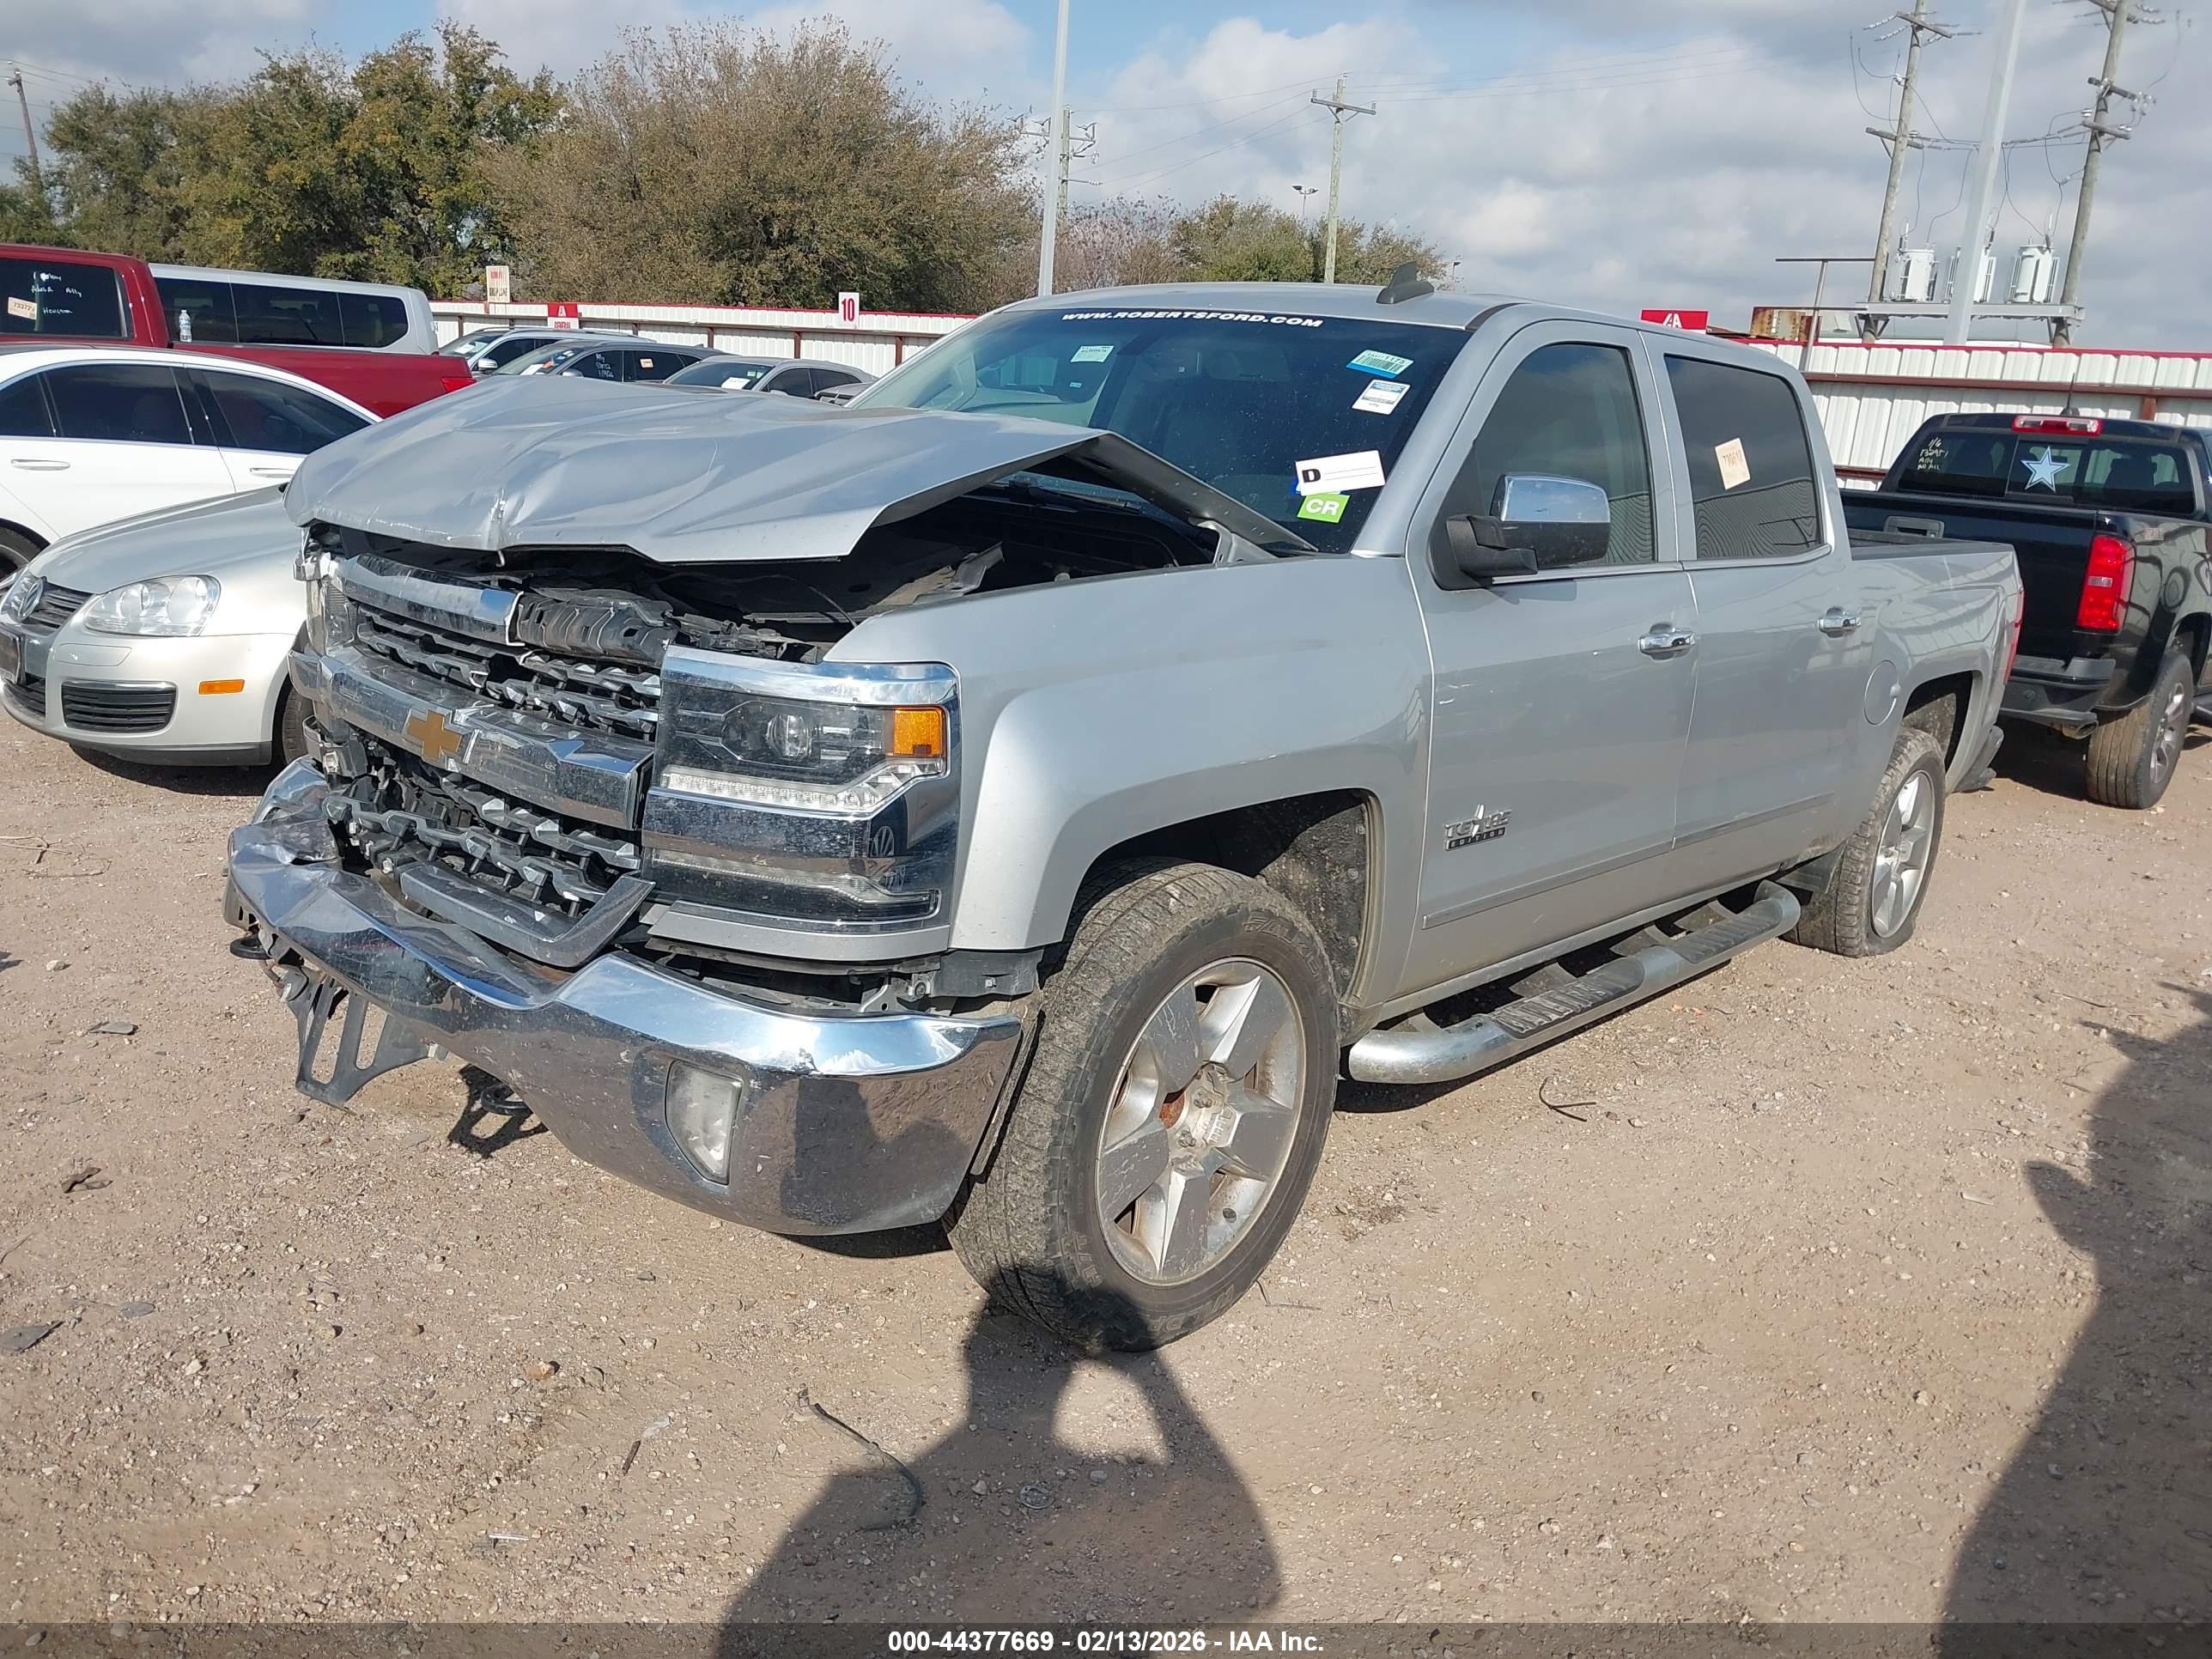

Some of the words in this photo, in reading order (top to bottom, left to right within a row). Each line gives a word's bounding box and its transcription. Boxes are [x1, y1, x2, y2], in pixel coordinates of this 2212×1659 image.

[842, 298, 855, 322] 10
[1062, 311, 1323, 327] WWW.ROBERTSFORD.COM
[1302, 469, 1322, 483] D
[1306, 499, 1340, 516] CR
[1447, 827, 1506, 849] EDITION
